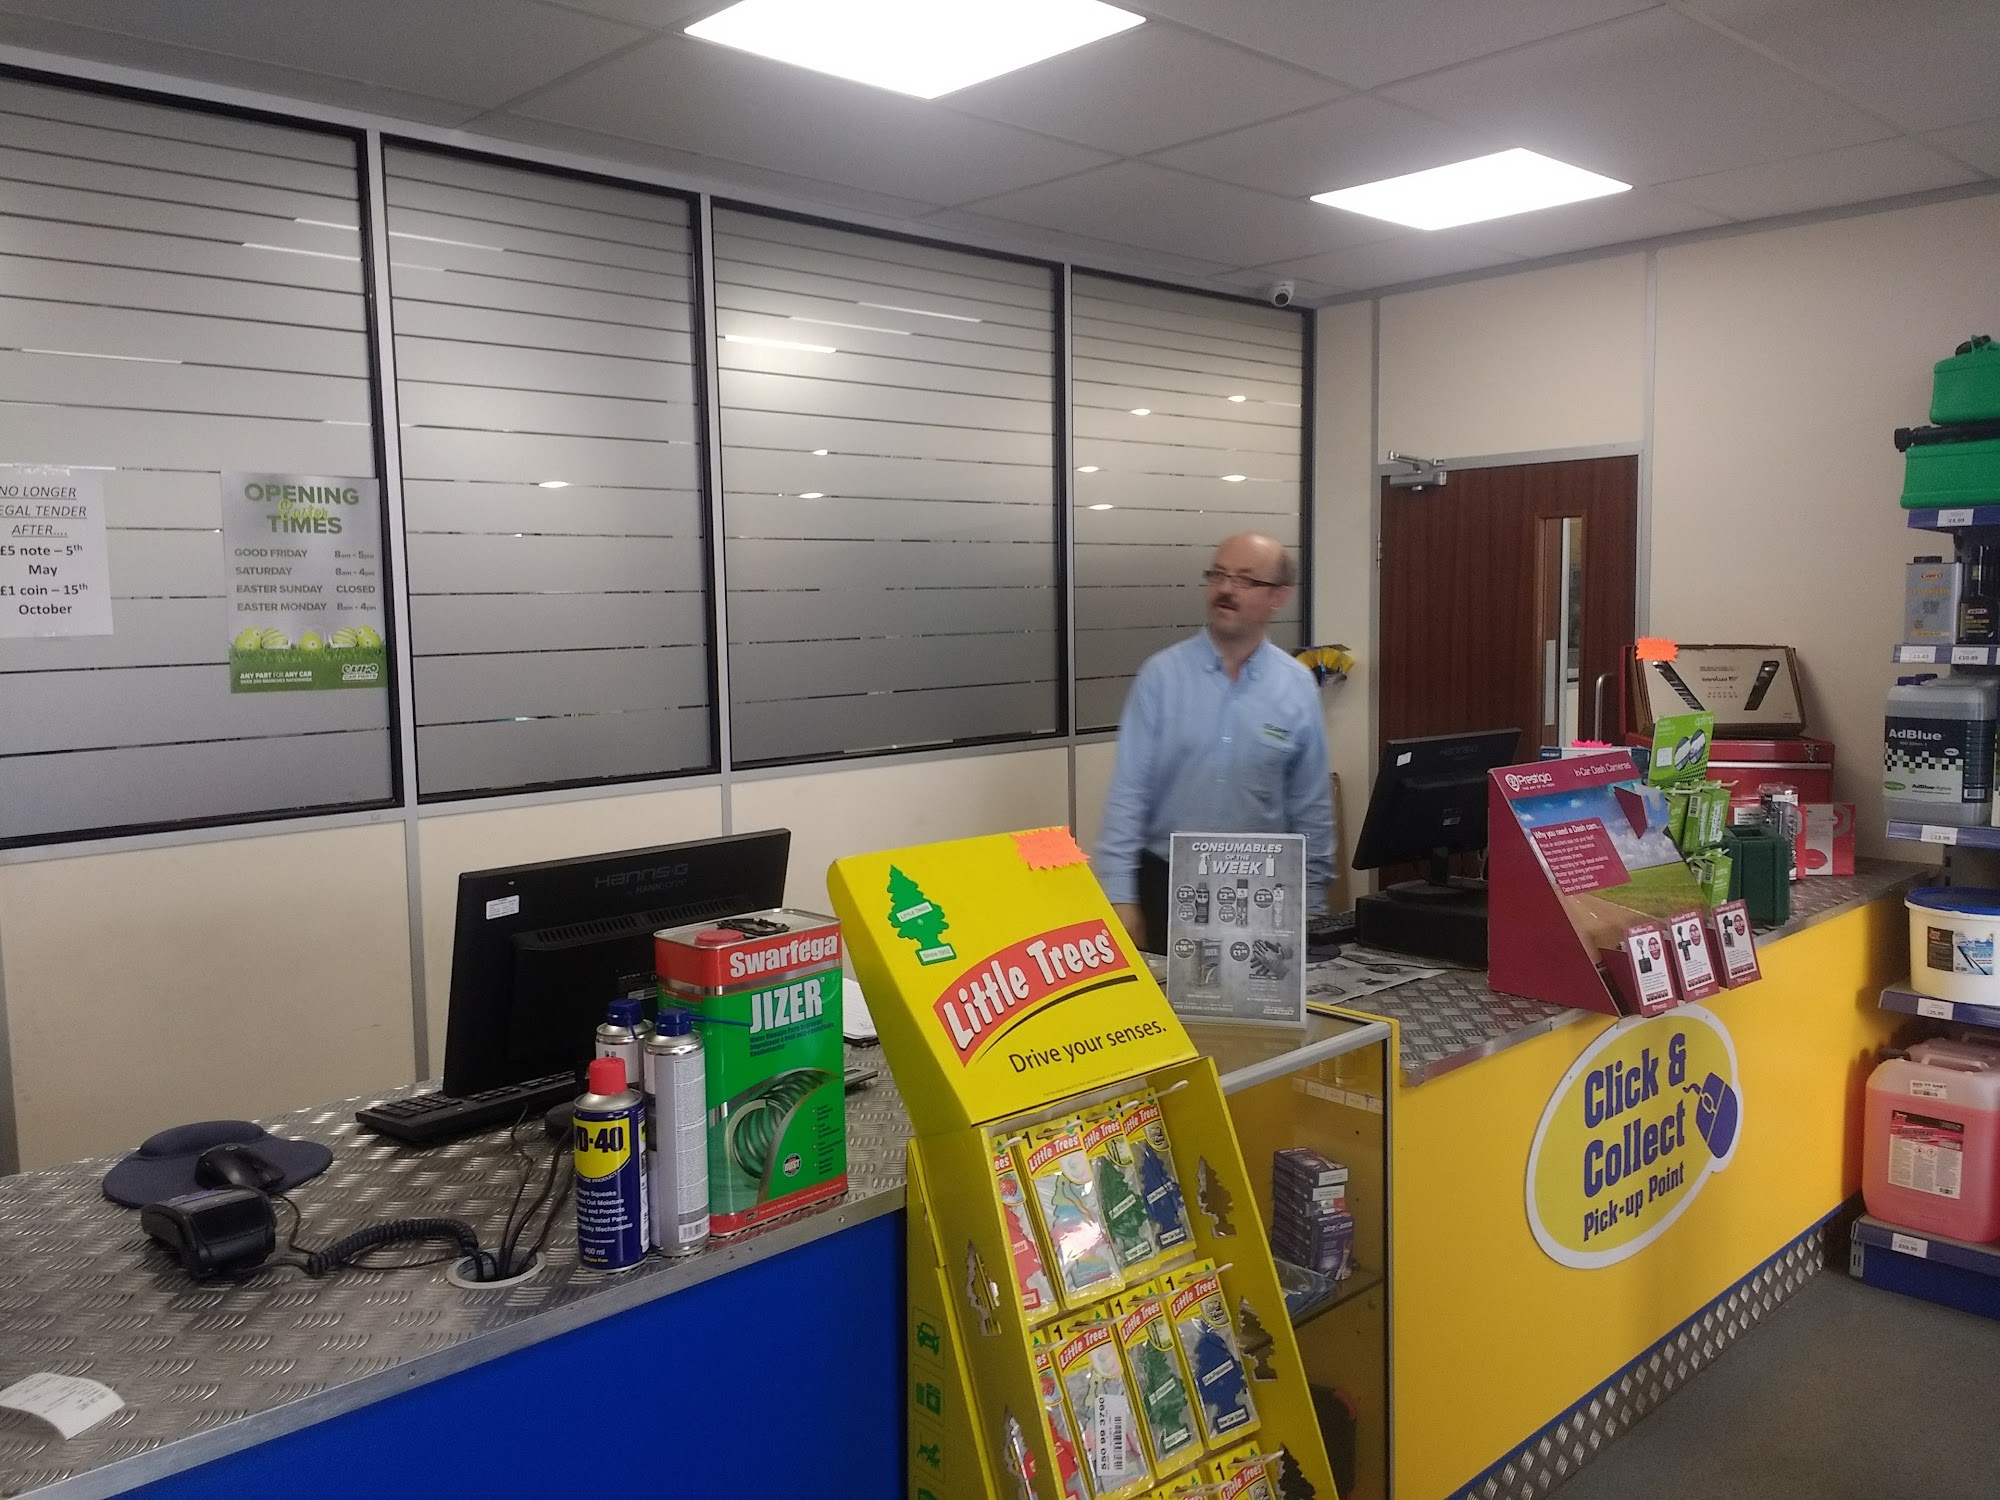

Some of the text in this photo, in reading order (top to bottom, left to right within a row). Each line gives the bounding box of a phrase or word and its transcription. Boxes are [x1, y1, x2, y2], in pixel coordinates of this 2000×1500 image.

[0, 486, 77, 498] NO LONGER
[244, 483, 360, 505] OPENING
[36, 505, 87, 517] TENDER
[266, 515, 343, 534] TIMES
[0, 545, 16, 556] £5
[20, 545, 50, 556] note
[66, 543, 83, 556] 5th
[234, 548, 268, 558] GOOD
[270, 549, 308, 558] FRIDAY
[28, 564, 58, 577] May
[235, 566, 293, 576] SATURDAY
[0, 585, 15, 596] £1
[20, 584, 48, 596] coin
[63, 582, 88, 596] 15th
[236, 584, 376, 594] EASTER SUNDAY CLOSED
[18, 603, 72, 615] October
[237, 603, 278, 611] EASTER
[280, 603, 327, 611] MONDAY
[1888, 728, 1942, 741] AdBlue
[1591, 766, 1606, 775] Dash
[1606, 762, 1632, 772] Cameras
[1519, 772, 1552, 785] Prestigio
[1533, 831, 1546, 840] Why
[1546, 830, 1556, 839] you
[1556, 827, 1569, 836] need
[1572, 825, 1586, 833] Dash
[1191, 842, 1283, 854] CONSUMABLES
[1212, 861, 1263, 876] WEEK
[729, 935, 838, 978] Swarfega
[943, 934, 1115, 1050] Little Trees
[749, 979, 823, 1034] JIZER
[1008, 1019, 1168, 1073] Drive your senses.
[1584, 1033, 1686, 1129] Click &
[1123, 1107, 1159, 1135] ittle Trees
[576, 1125, 624, 1153] D-40
[1022, 1131, 1032, 1149] 1
[1084, 1121, 1120, 1151] ittle Trees
[1028, 1134, 1079, 1172] Little Trees
[1583, 1099, 1685, 1198] Collect
[591, 1190, 617, 1199] Squeaks
[597, 1198, 625, 1206] Moisture
[1583, 1161, 1684, 1242] Pick-up Point
[599, 1206, 626, 1214] Protects
[590, 1214, 629, 1223] Rusted Parts
[595, 1222, 633, 1233] Mechanisms
[584, 1247, 605, 1256] 400 ml
[1166, 1276, 1174, 1291] 1
[1172, 1278, 1217, 1317] Little Trees
[1115, 1299, 1123, 1315] 1
[1121, 1303, 1160, 1341] Little Trees
[1054, 1324, 1063, 1340] 1
[1060, 1341, 1083, 1368] Little
[1083, 1327, 1108, 1346] Trees
[1222, 1464, 1263, 1500] Little Trees
